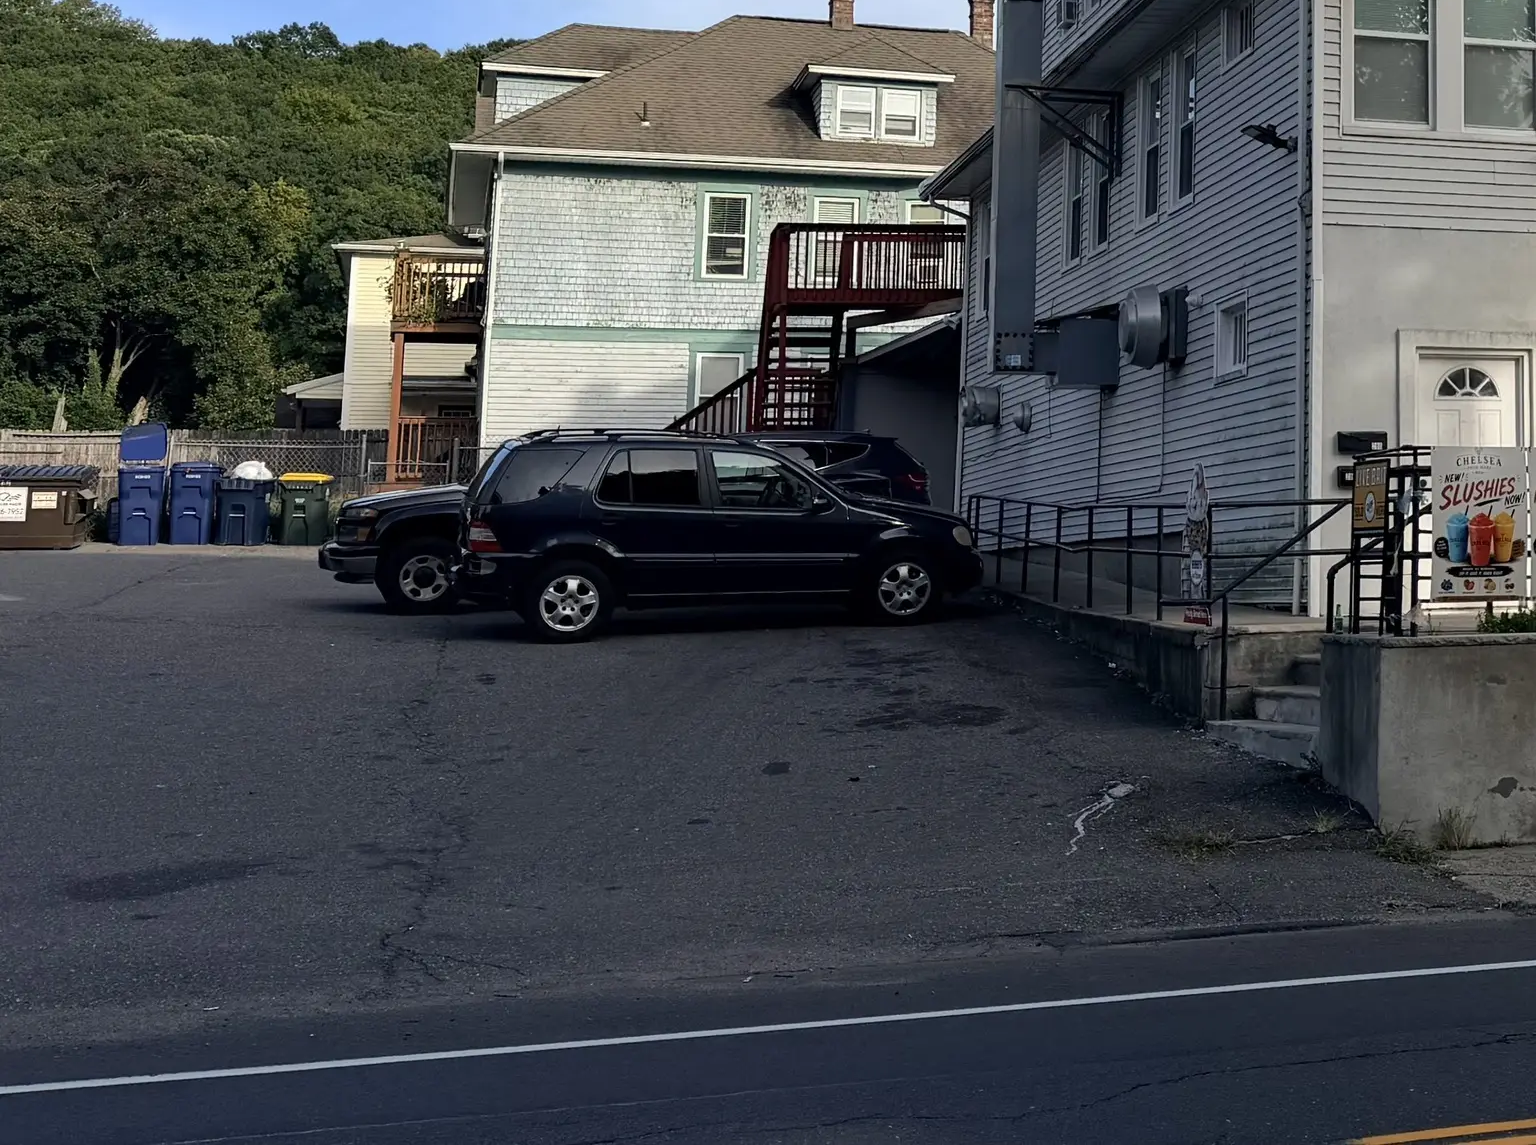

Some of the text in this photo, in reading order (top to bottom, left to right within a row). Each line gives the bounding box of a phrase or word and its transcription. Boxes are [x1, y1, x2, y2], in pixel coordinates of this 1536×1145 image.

[1456, 455, 1502, 467] CHELSEA
[1444, 472, 1465, 484] NEW!
[1439, 476, 1516, 511] SLUSHIES
[1504, 491, 1526, 506] NOW!
